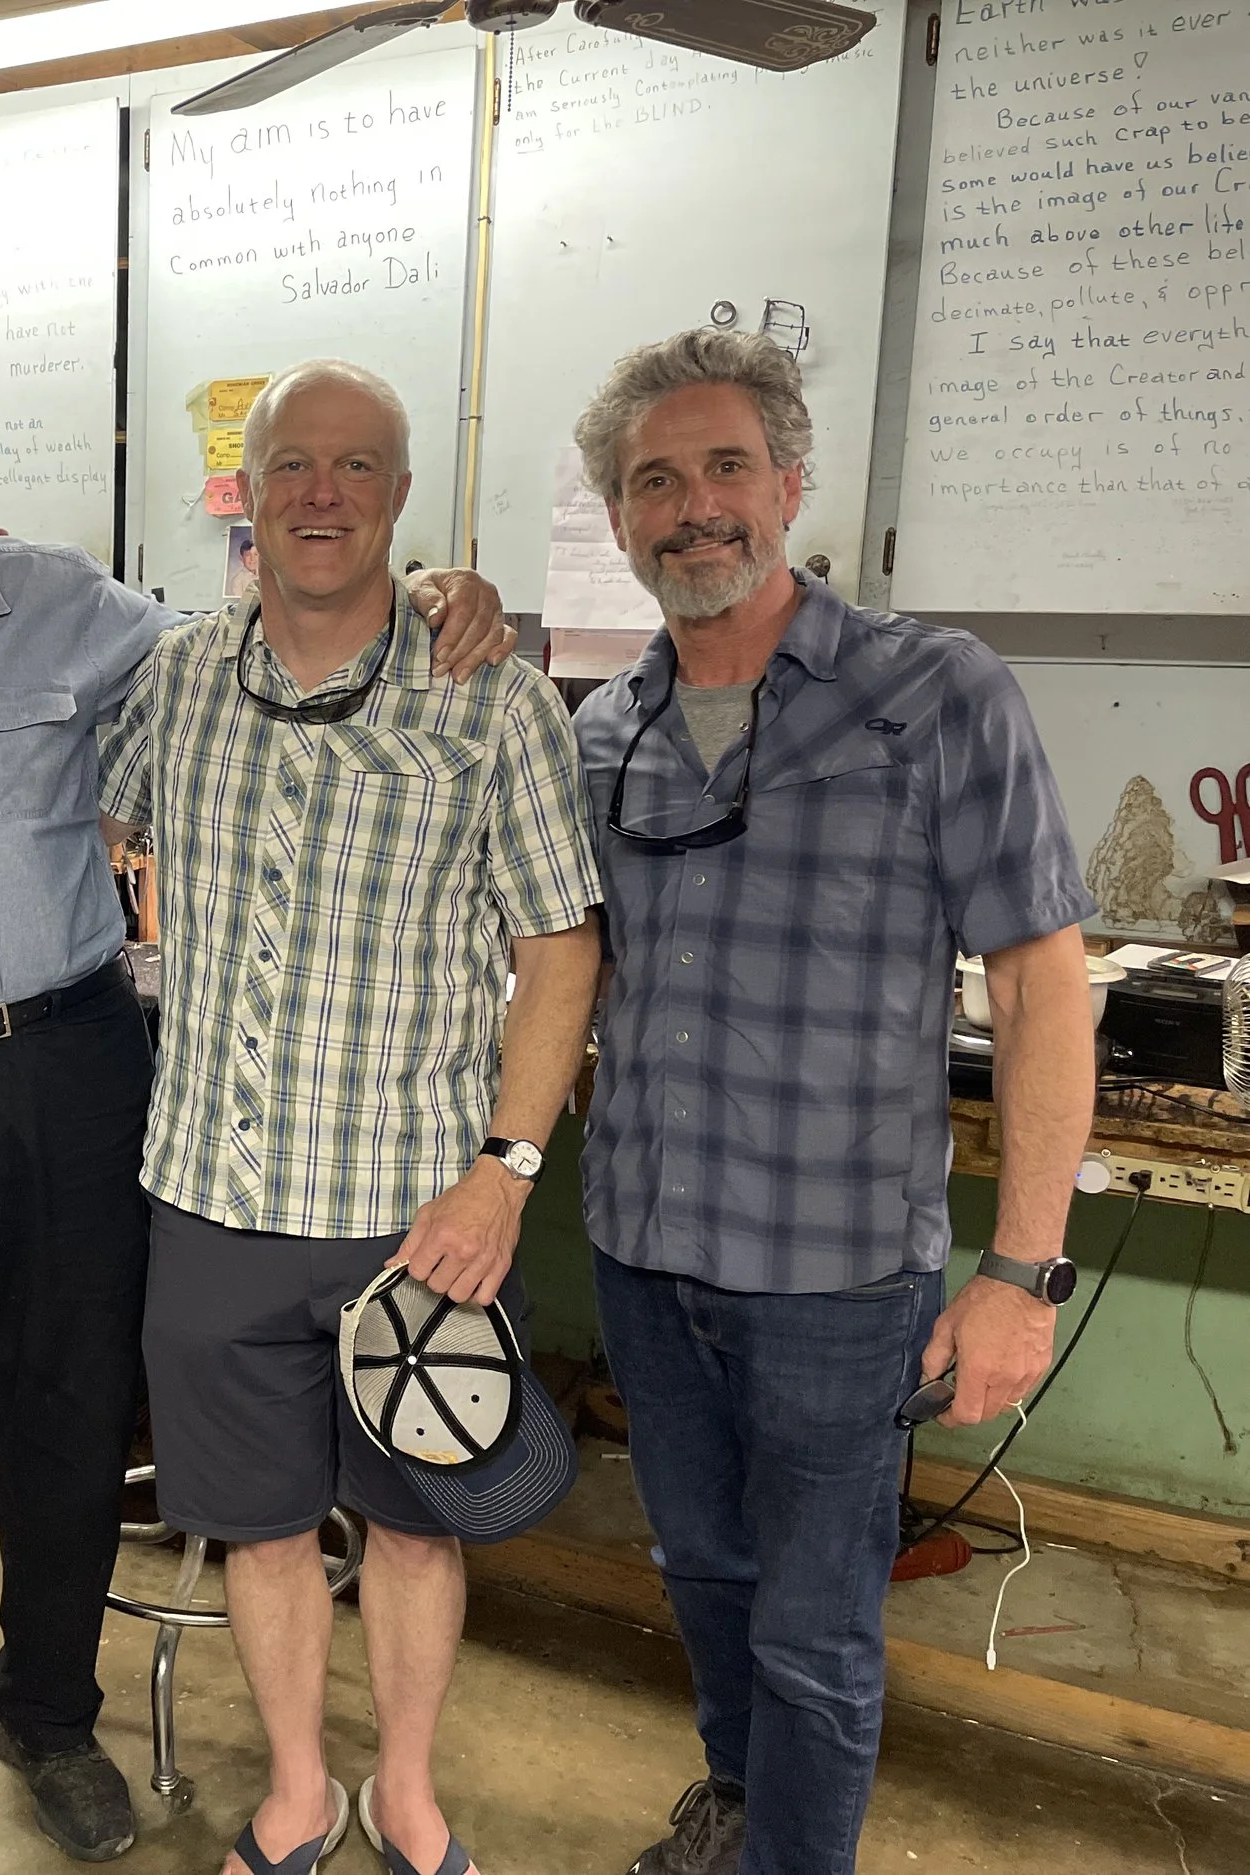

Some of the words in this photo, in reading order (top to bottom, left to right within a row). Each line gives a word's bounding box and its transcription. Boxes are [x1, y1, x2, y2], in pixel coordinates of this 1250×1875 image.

[955, 33, 1065, 63] neither
[1078, 26, 1125, 45] was
[1139, 22, 1158, 38] it
[1171, 10, 1231, 32] ever
[514, 73, 544, 95] the
[646, 50, 679, 72] day
[515, 47, 557, 66] After
[951, 76, 999, 100] the
[515, 110, 537, 121] am
[515, 130, 544, 149] only
[555, 122, 580, 141] for
[634, 98, 711, 124] BLIND.
[997, 107, 1096, 129] Because
[1113, 89, 1143, 116] of
[1156, 98, 1198, 112] our
[170, 129, 214, 179] My
[230, 123, 291, 154] aim
[309, 123, 331, 140] is
[344, 111, 375, 135] to
[389, 89, 447, 126] have
[943, 136, 1031, 164] believed
[1045, 130, 1098, 150] such
[1181, 119, 1208, 131] to
[1221, 111, 1250, 125] be
[1011, 161, 1074, 183] would
[1086, 158, 1135, 175] have
[1146, 157, 1174, 171] us
[172, 179, 295, 226] absolutely
[311, 169, 397, 207] nothing
[419, 165, 442, 184] in
[943, 202, 966, 223] is
[976, 199, 1022, 216] the
[1038, 190, 1107, 212] image
[1123, 177, 1146, 202] of
[1161, 182, 1199, 196] our
[1214, 167, 1250, 194] Cr
[273, 228, 321, 259] with
[337, 226, 416, 258] anyone
[940, 223, 1008, 254] much
[1030, 223, 1101, 245] above
[1118, 212, 1194, 239] other
[1205, 202, 1244, 235] life
[281, 268, 371, 305] Salvador
[382, 251, 440, 289] Dali
[940, 261, 1045, 286] Because
[1068, 247, 1099, 275] of
[1112, 252, 1191, 272] these
[931, 296, 1044, 323] decimate,
[1050, 285, 1149, 323] pollute,
[6, 314, 39, 341] have
[968, 331, 989, 355] I
[1009, 338, 1056, 360] say
[1071, 325, 1132, 348] that
[10, 354, 84, 377] murderer.
[928, 376, 1000, 401] image
[1016, 367, 1040, 391] of
[1049, 367, 1095, 388] the
[1109, 363, 1199, 386] Creator
[1206, 362, 1246, 380] and
[5, 420, 24, 431] not
[928, 405, 1008, 433] general
[1025, 402, 1104, 424] order
[1119, 396, 1148, 421] of
[1160, 396, 1244, 429] things.
[26, 434, 38, 454] of
[46, 433, 91, 453] wealth
[994, 445, 1082, 472] occupy
[1105, 438, 1130, 455] is
[1153, 433, 1182, 456] of
[1203, 439, 1231, 456] no
[56, 462, 107, 494] display
[929, 478, 1067, 502] importance
[1077, 470, 1127, 493] than
[1136, 466, 1186, 492] that
[1196, 464, 1224, 492] of
